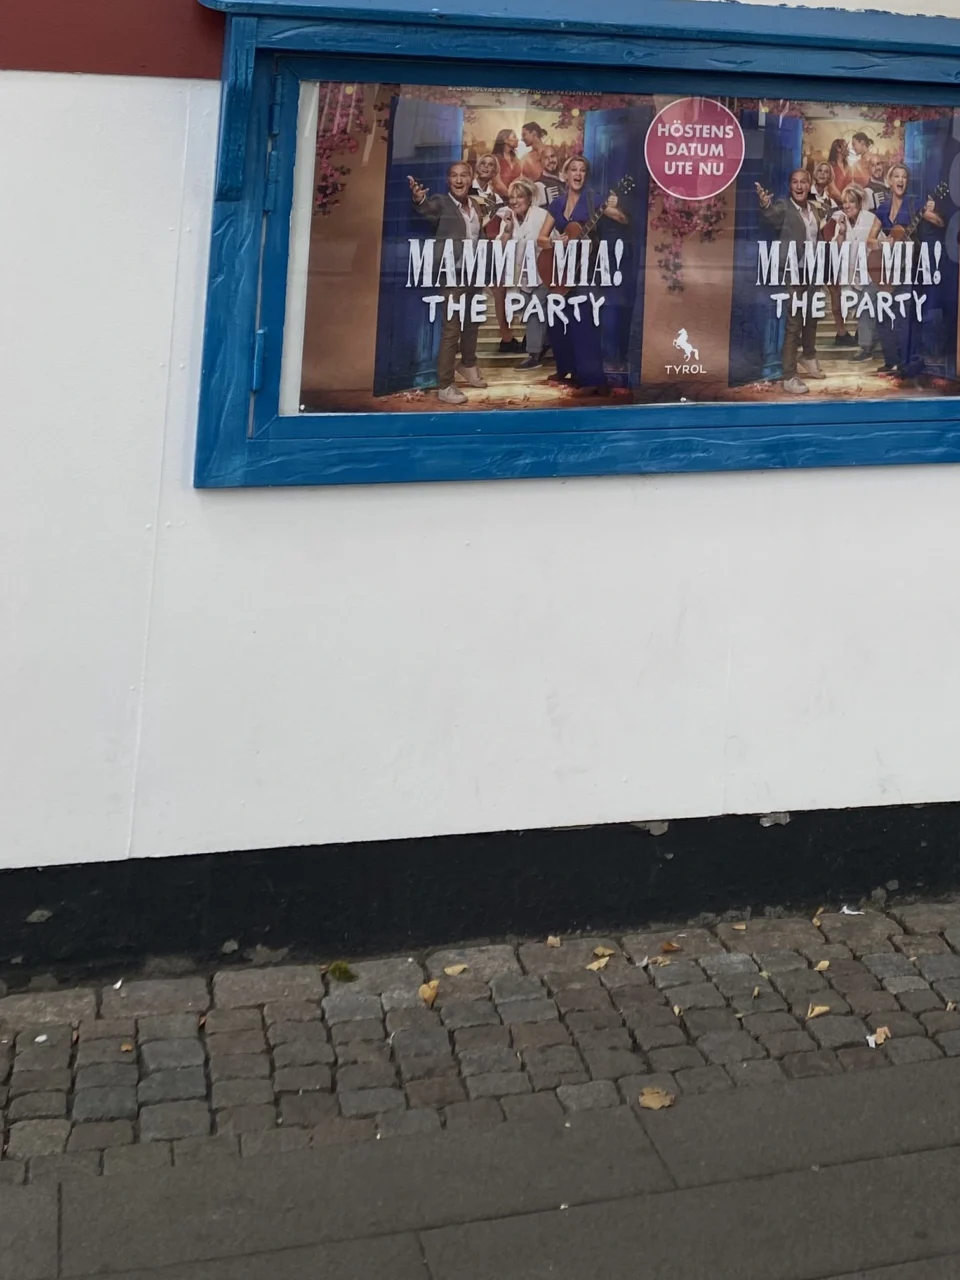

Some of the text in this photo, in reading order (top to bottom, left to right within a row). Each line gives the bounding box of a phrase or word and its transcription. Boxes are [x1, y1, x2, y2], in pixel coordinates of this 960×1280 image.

[657, 120, 734, 139] HÖSTENS
[665, 142, 724, 157] DATUM
[664, 161, 724, 176] UTE NU
[405, 238, 625, 288] MAMMA MIA!
[755, 240, 942, 287] MAMMA MIA!
[422, 292, 606, 334] THE PARTY
[770, 290, 928, 330] THE PARTY
[664, 364, 708, 375] TYROL
